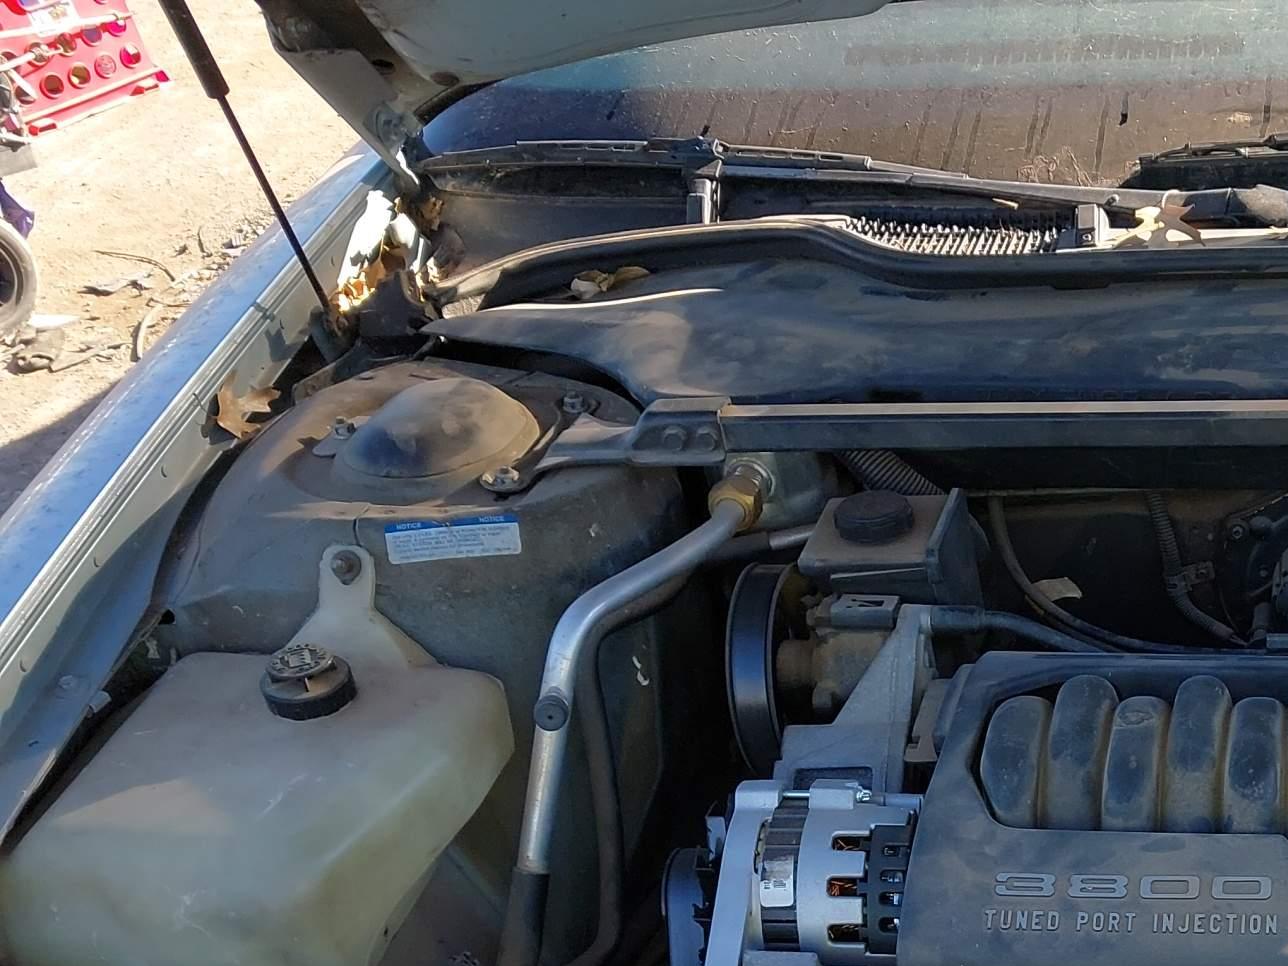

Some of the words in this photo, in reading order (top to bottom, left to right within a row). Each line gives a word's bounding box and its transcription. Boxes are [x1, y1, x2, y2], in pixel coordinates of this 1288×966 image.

[396, 522, 422, 530] NOTICE
[994, 871, 1273, 900] 3800
[984, 909, 1060, 931] TUNED
[1076, 911, 1137, 933] PORT
[1152, 912, 1278, 936] INJECTION
